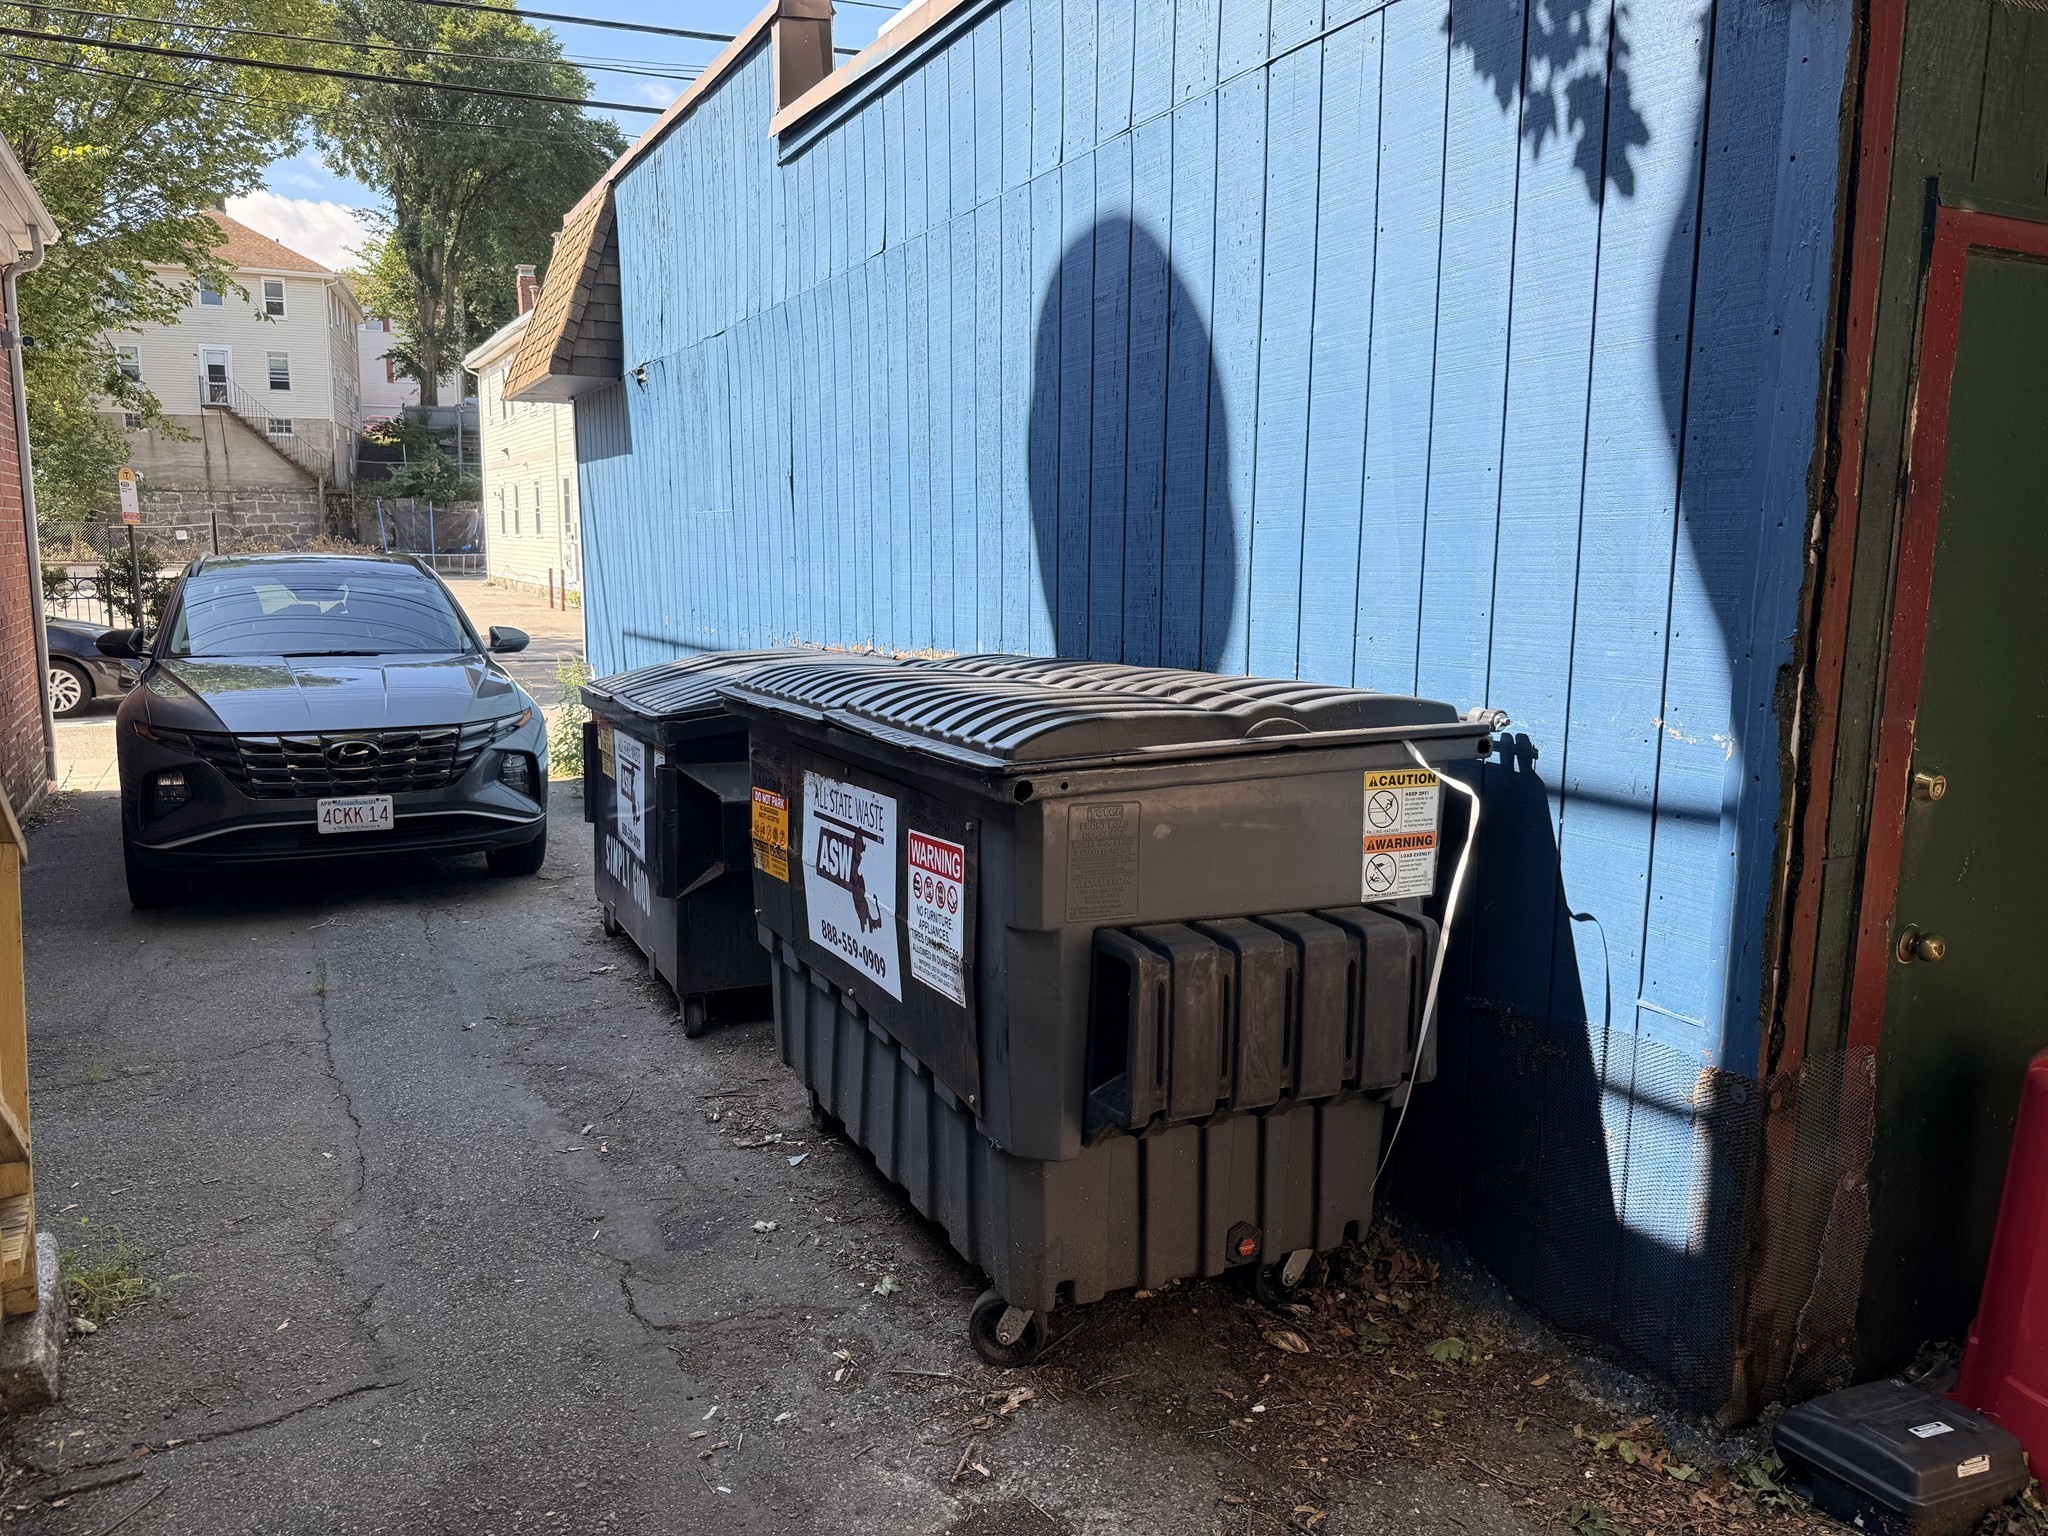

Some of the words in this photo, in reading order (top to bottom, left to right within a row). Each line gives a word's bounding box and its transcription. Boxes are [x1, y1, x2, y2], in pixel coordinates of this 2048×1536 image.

[1379, 774, 1436, 786] CAUTION
[754, 791, 761, 802] DO
[762, 794, 771, 806] NOT
[772, 795, 785, 810] PARK
[814, 780, 828, 810] ALL
[830, 788, 852, 820] STATE
[854, 798, 884, 832] WASTE
[323, 807, 364, 824] 4CKK
[370, 805, 388, 822] 14
[1082, 830, 1127, 839] CONTAINER
[1376, 835, 1432, 850] WARNING
[819, 834, 854, 882] ASW
[910, 838, 961, 879] WARNING
[606, 833, 630, 892] SIMPLY
[632, 861, 651, 917] GOOD
[916, 904, 923, 917] NO
[924, 908, 953, 932] FURNITURE,
[911, 928, 924, 944] TIRES
[918, 919, 950, 946] APPLIANCES,
[822, 919, 886, 978] 888-559-0909
[913, 943, 932, 960] ALLOWED
[932, 953, 936, 962] IN
[937, 956, 960, 974] DUMPSTER
